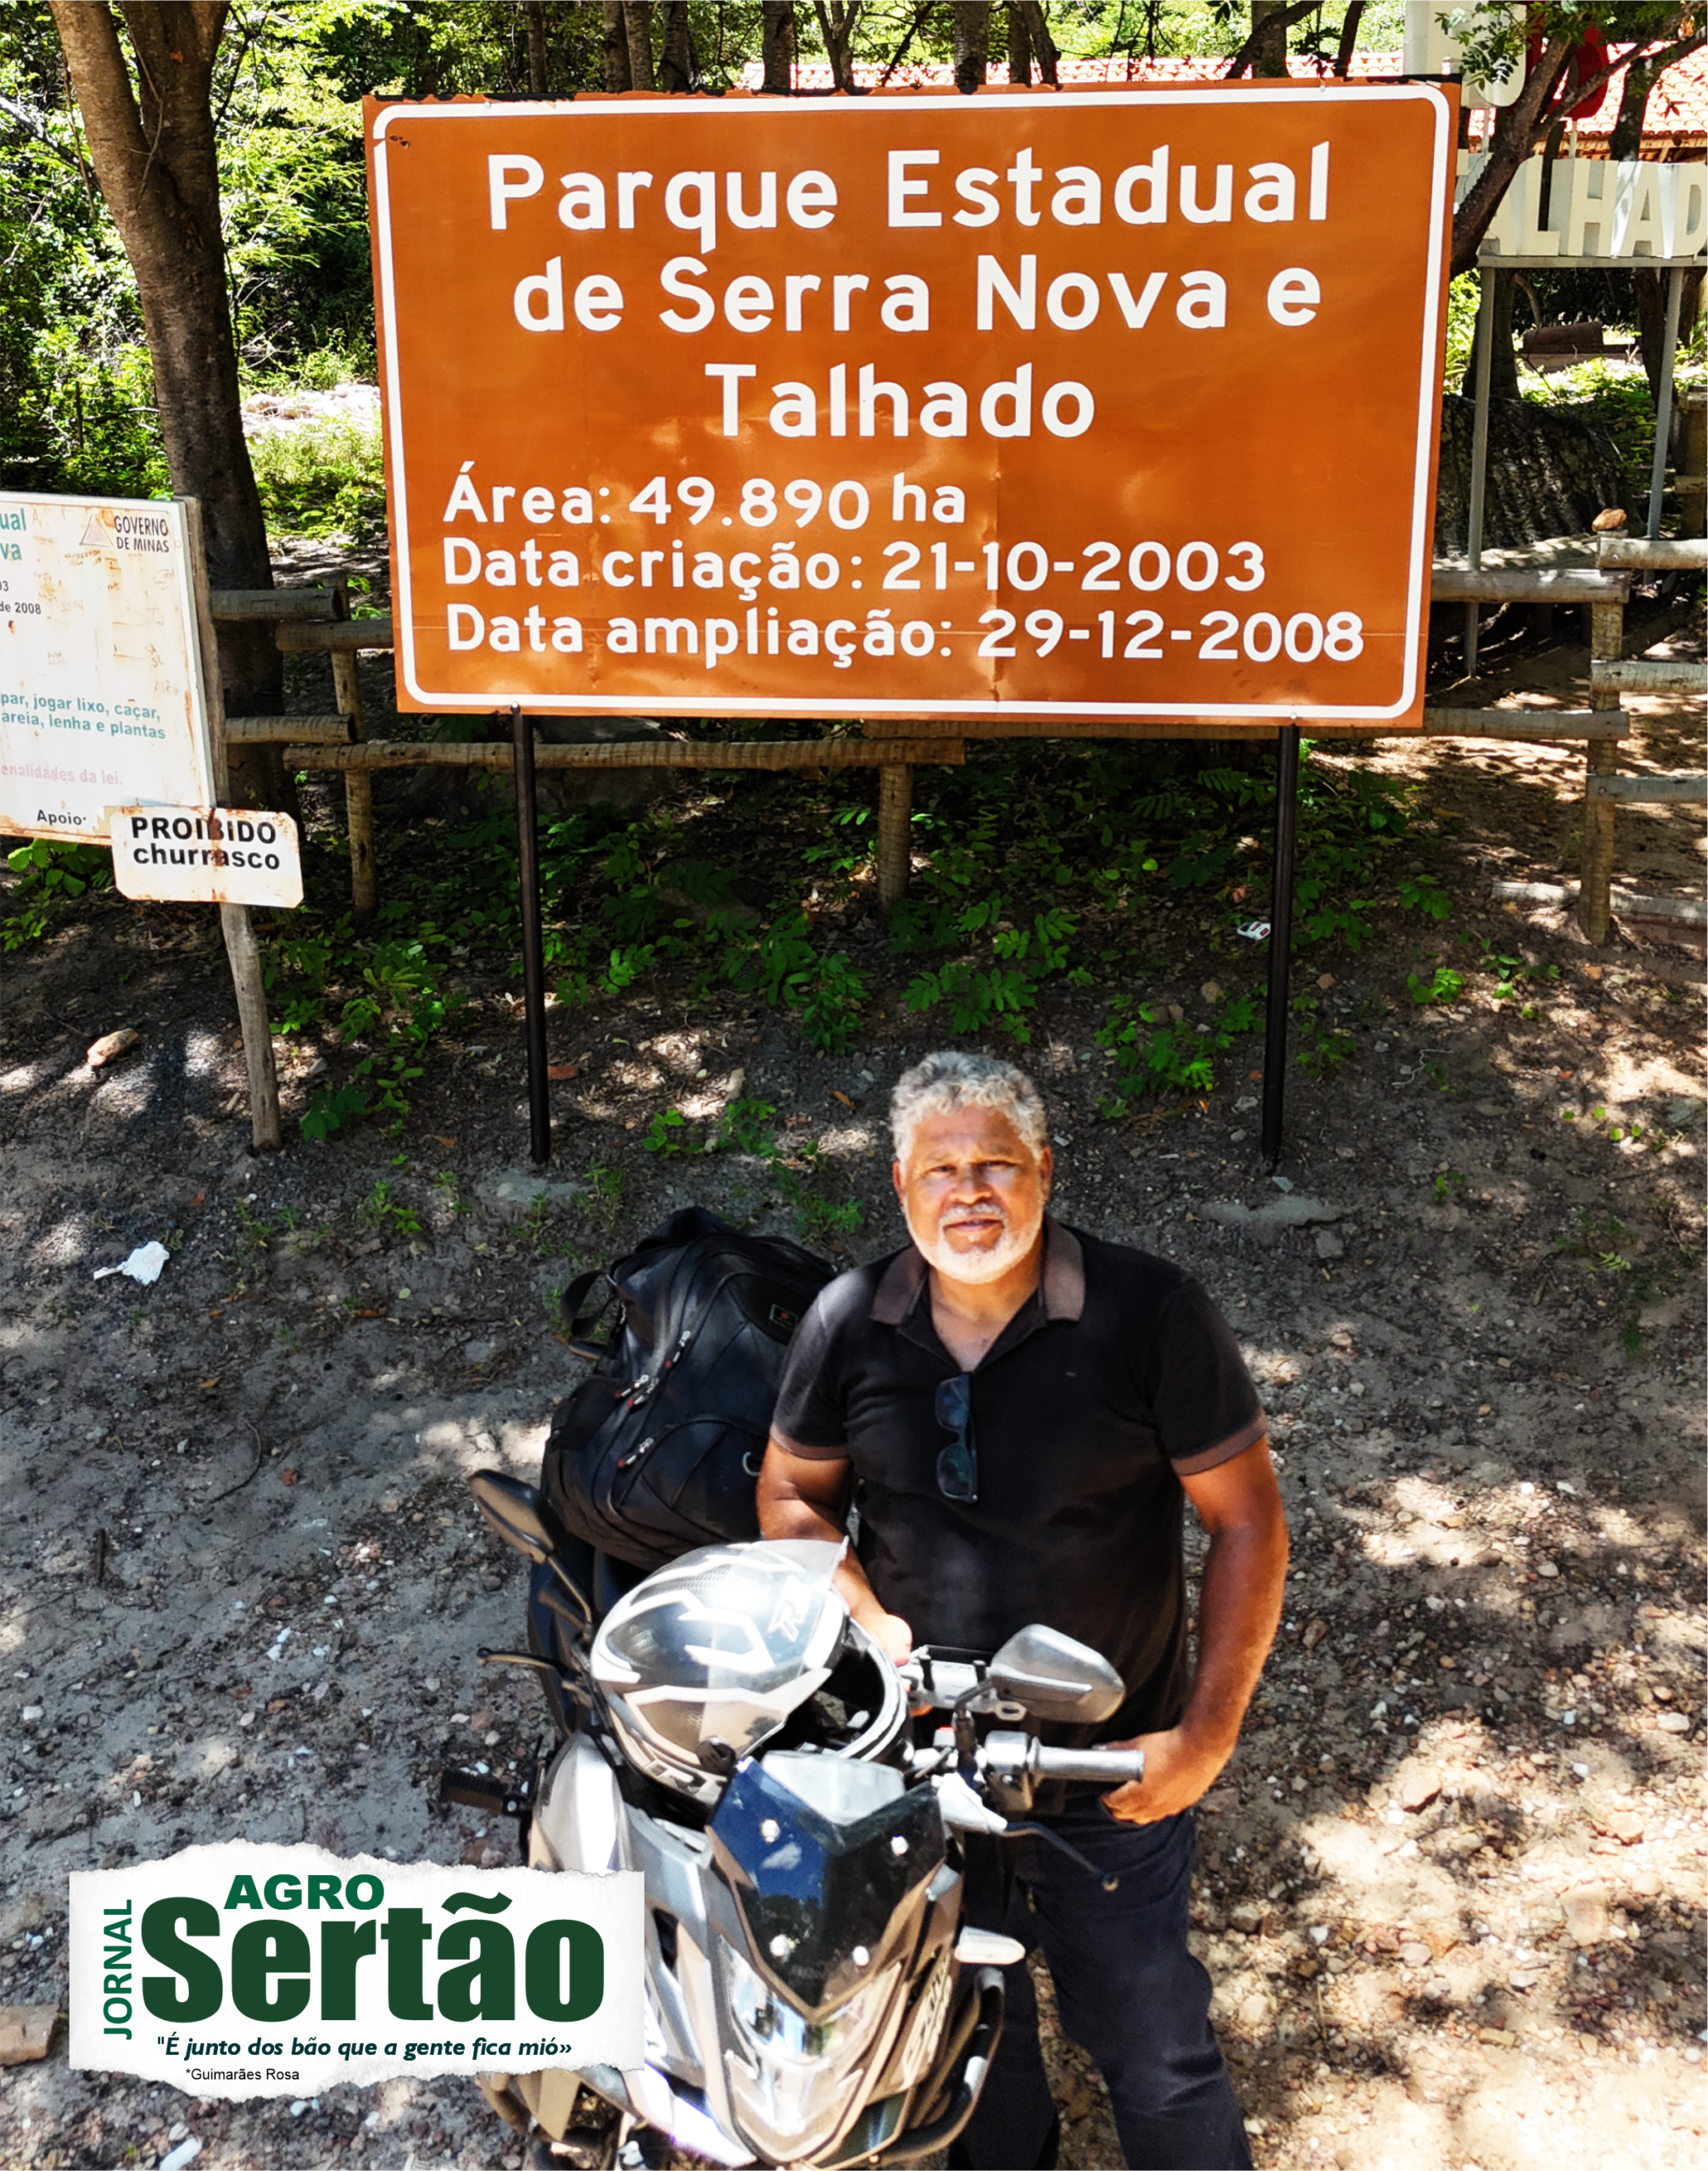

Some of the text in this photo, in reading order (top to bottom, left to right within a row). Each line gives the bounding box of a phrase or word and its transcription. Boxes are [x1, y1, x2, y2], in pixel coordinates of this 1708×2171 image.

[488, 141, 1330, 254] Parque Estadual
[513, 254, 1320, 333] de Serra Nova e
[705, 363, 1095, 438] Talhado
[443, 460, 965, 530] Área: 49.890 ha
[0, 507, 26, 531] ual
[114, 515, 169, 537] GOVERNO
[0, 543, 22, 561] va
[116, 537, 170, 553] DE MINAS
[443, 537, 1265, 601] Data criação: 21-10-2003
[14, 601, 42, 615] 2008
[447, 603, 1364, 669] Data ampliação: 29-12-2008
[0, 693, 161, 723] par, jogar lixo, caçar,
[1, 712, 166, 739] areia, lenha e plantas
[80, 768, 98, 784] da
[101, 769, 124, 785] lei.
[131, 816, 276, 845] PROIBIDO
[133, 842, 281, 871] churrasco
